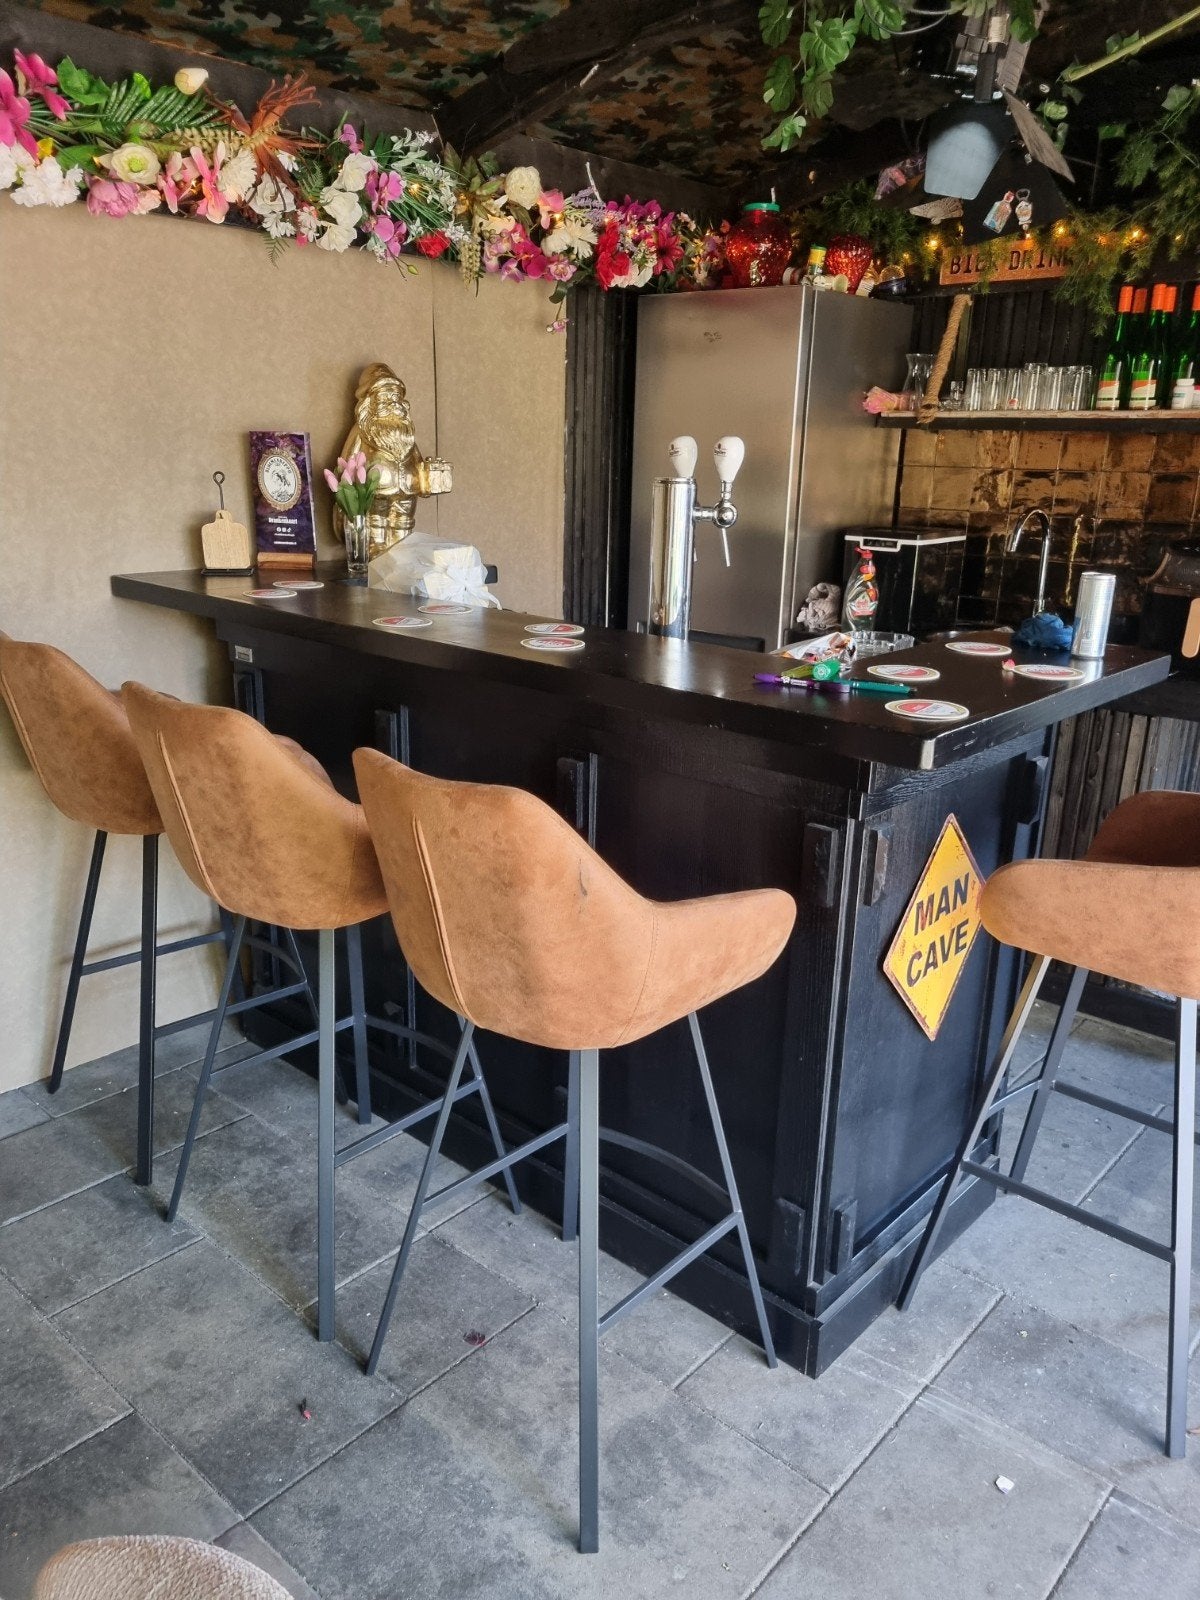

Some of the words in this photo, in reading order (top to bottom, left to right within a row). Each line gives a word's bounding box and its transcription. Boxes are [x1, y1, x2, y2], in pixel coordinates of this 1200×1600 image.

[950, 253, 999, 275] BIE
[914, 872, 970, 936] MAN
[906, 918, 970, 988] CAVE
